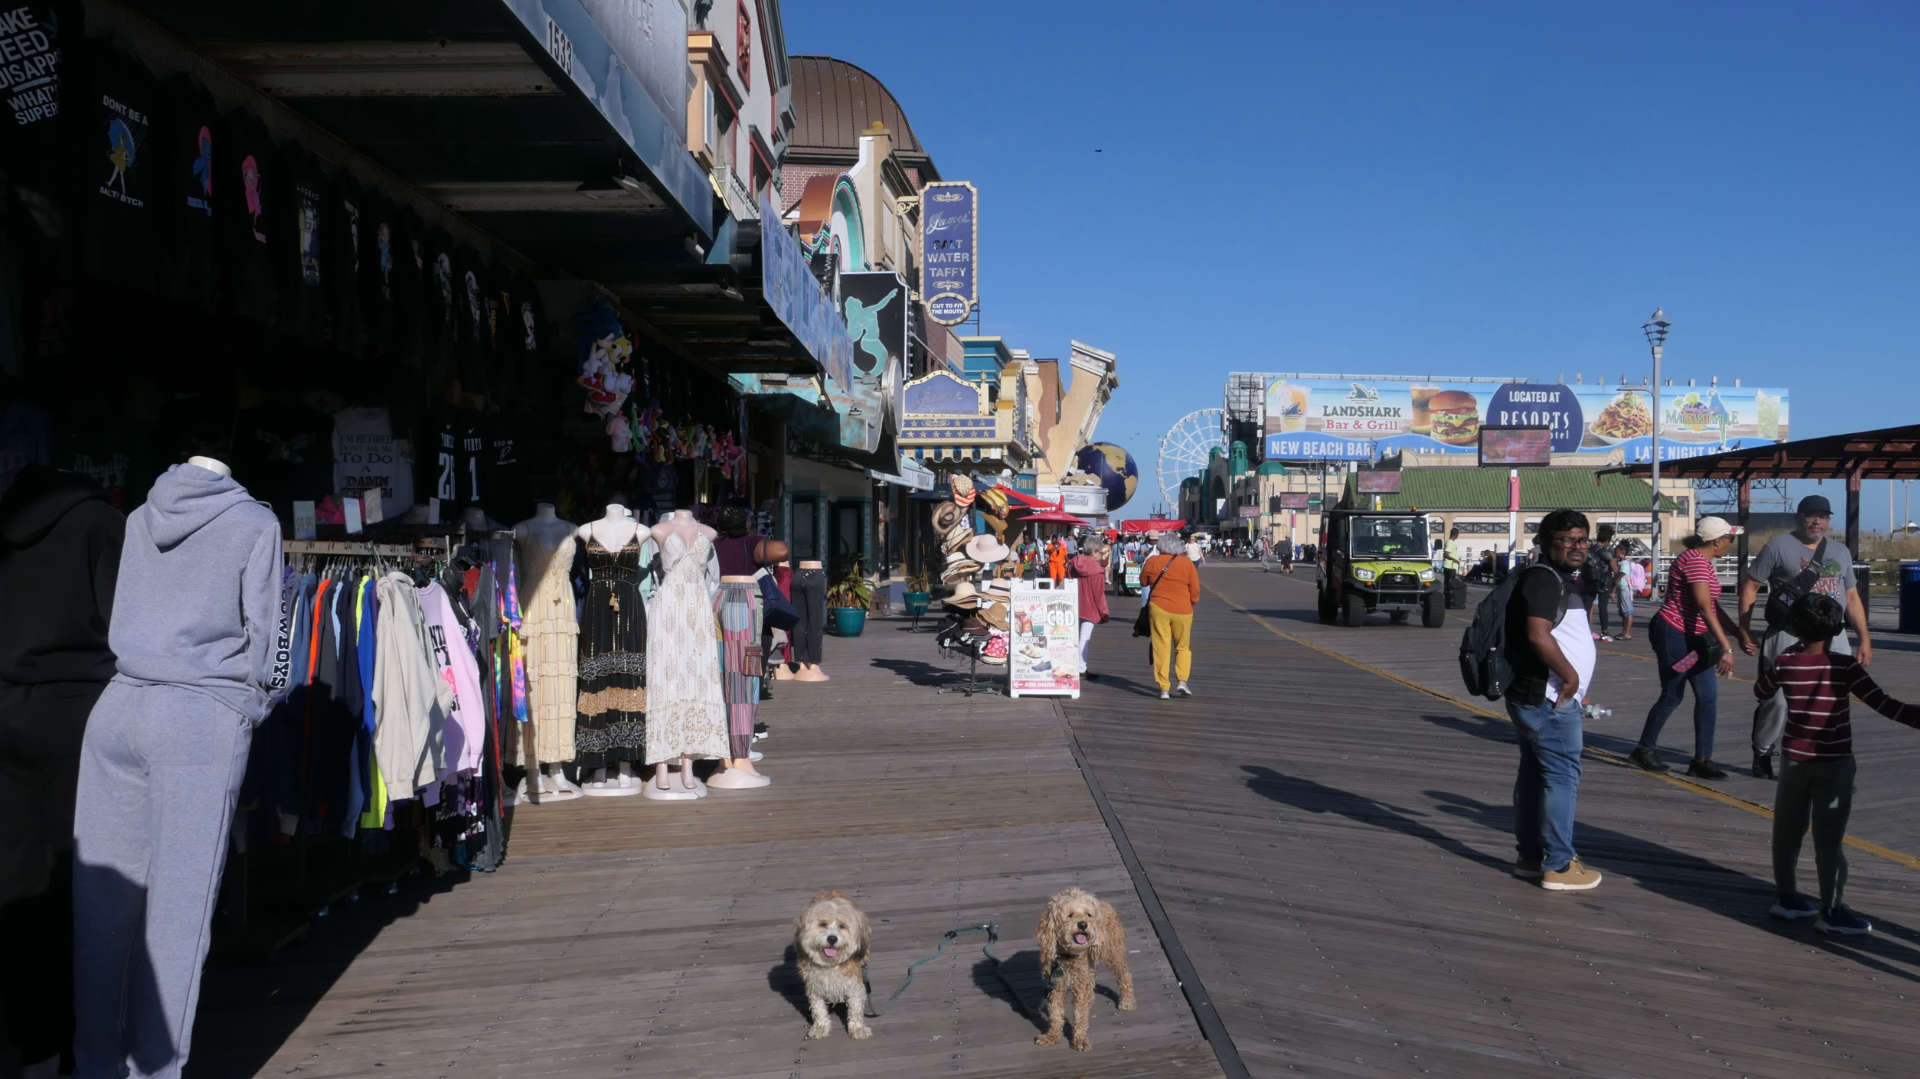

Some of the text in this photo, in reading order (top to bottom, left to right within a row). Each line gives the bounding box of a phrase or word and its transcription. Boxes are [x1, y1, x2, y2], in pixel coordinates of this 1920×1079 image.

[548, 20, 572, 76] 1533
[0, 52, 58, 90] DISAPP
[933, 239, 963, 250] SALT
[927, 252, 970, 263] WATER
[928, 267, 966, 278] TAFFY
[1509, 391, 1561, 403] LOCATED AT
[1322, 405, 1401, 418] LANDSHARK
[1326, 419, 1399, 431] Bar & Grill
[1271, 441, 1300, 456] NEW
[1303, 441, 1344, 457] BEACH
[1347, 442, 1371, 457] BAR
[1668, 446, 1705, 460] NIGHT
[1047, 609, 1074, 628] CBD
[271, 589, 291, 689] COWBOYS
